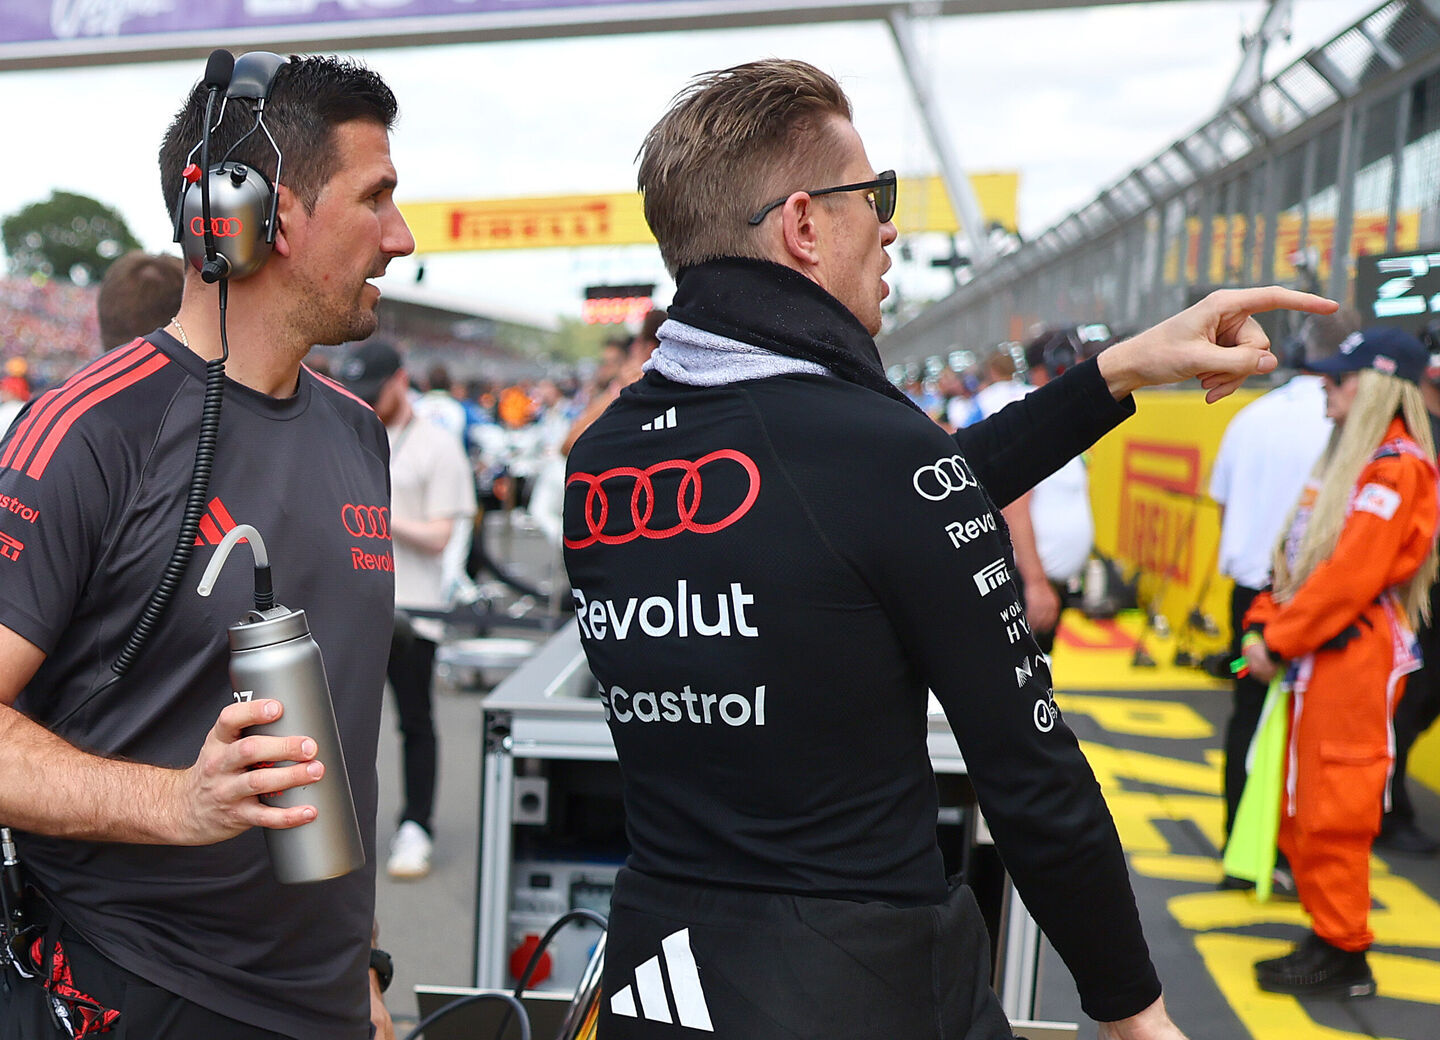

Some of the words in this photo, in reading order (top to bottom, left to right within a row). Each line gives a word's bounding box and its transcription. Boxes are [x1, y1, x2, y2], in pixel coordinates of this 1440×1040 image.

[1372, 252, 1440, 318] 2
[571, 579, 759, 641] Revolut
[610, 684, 766, 727] Castrol
